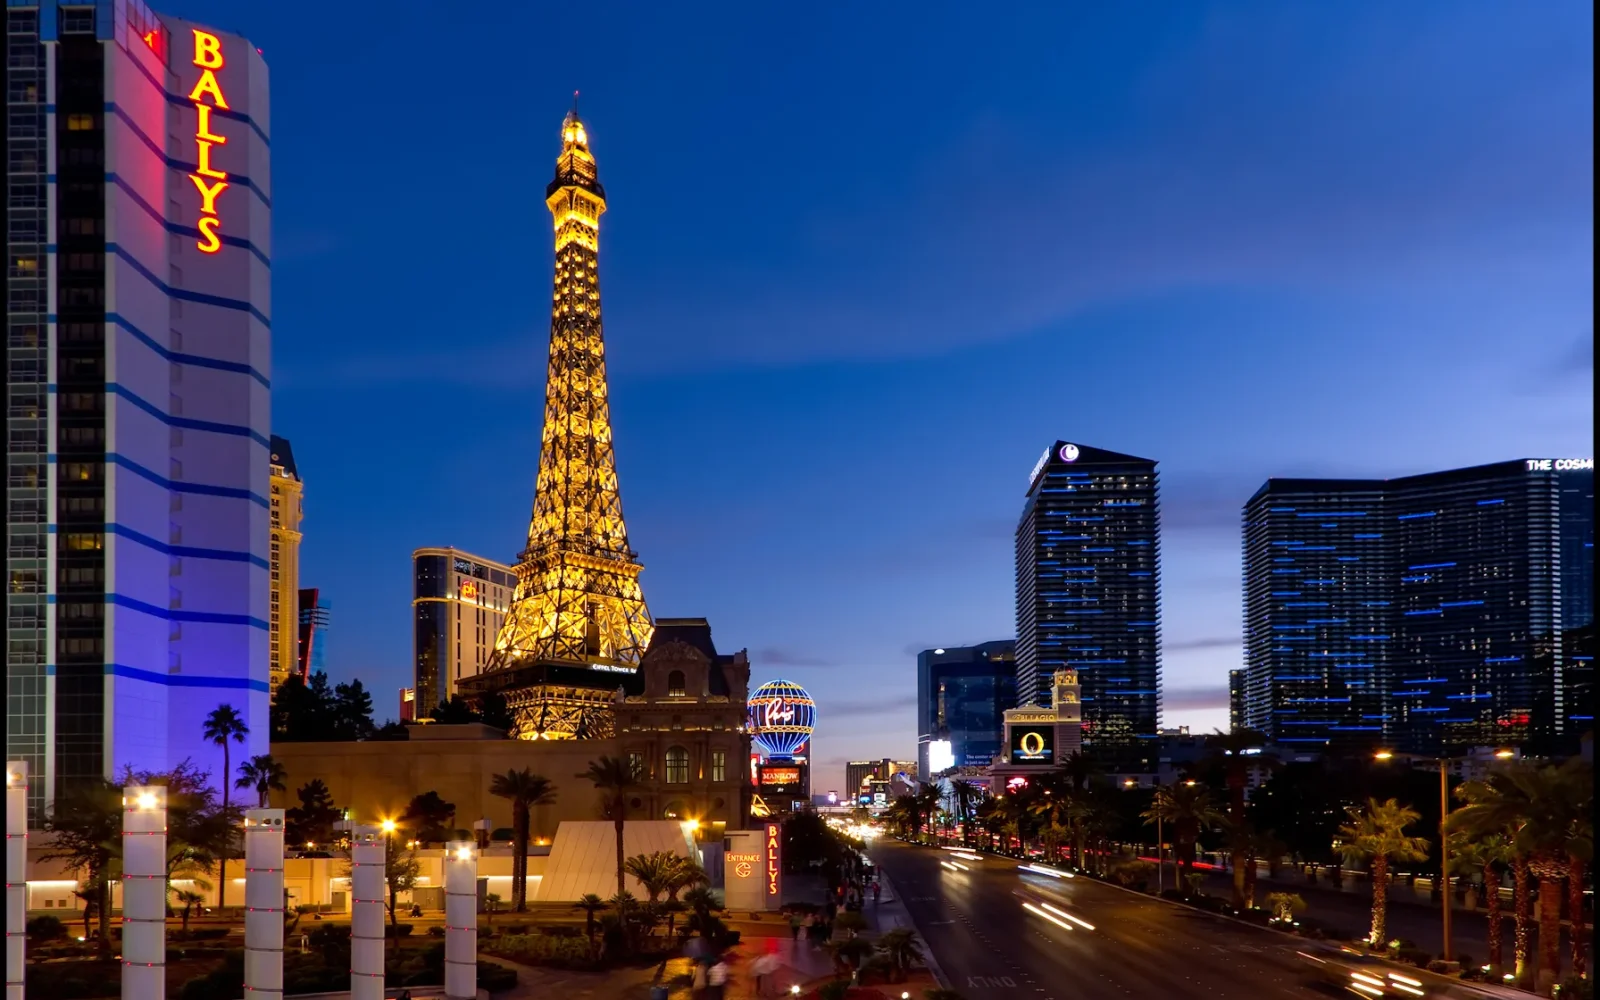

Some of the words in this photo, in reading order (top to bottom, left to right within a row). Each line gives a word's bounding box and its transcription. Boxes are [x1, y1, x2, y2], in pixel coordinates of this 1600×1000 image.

[188, 29, 229, 253] BALLYS
[1527, 459, 1552, 471] THE
[462, 582, 476, 596] ph
[765, 697, 795, 728] Paris
[1020, 732, 1045, 755] O
[767, 825, 779, 895] BALLYS
[967, 976, 1017, 988] ONLY
